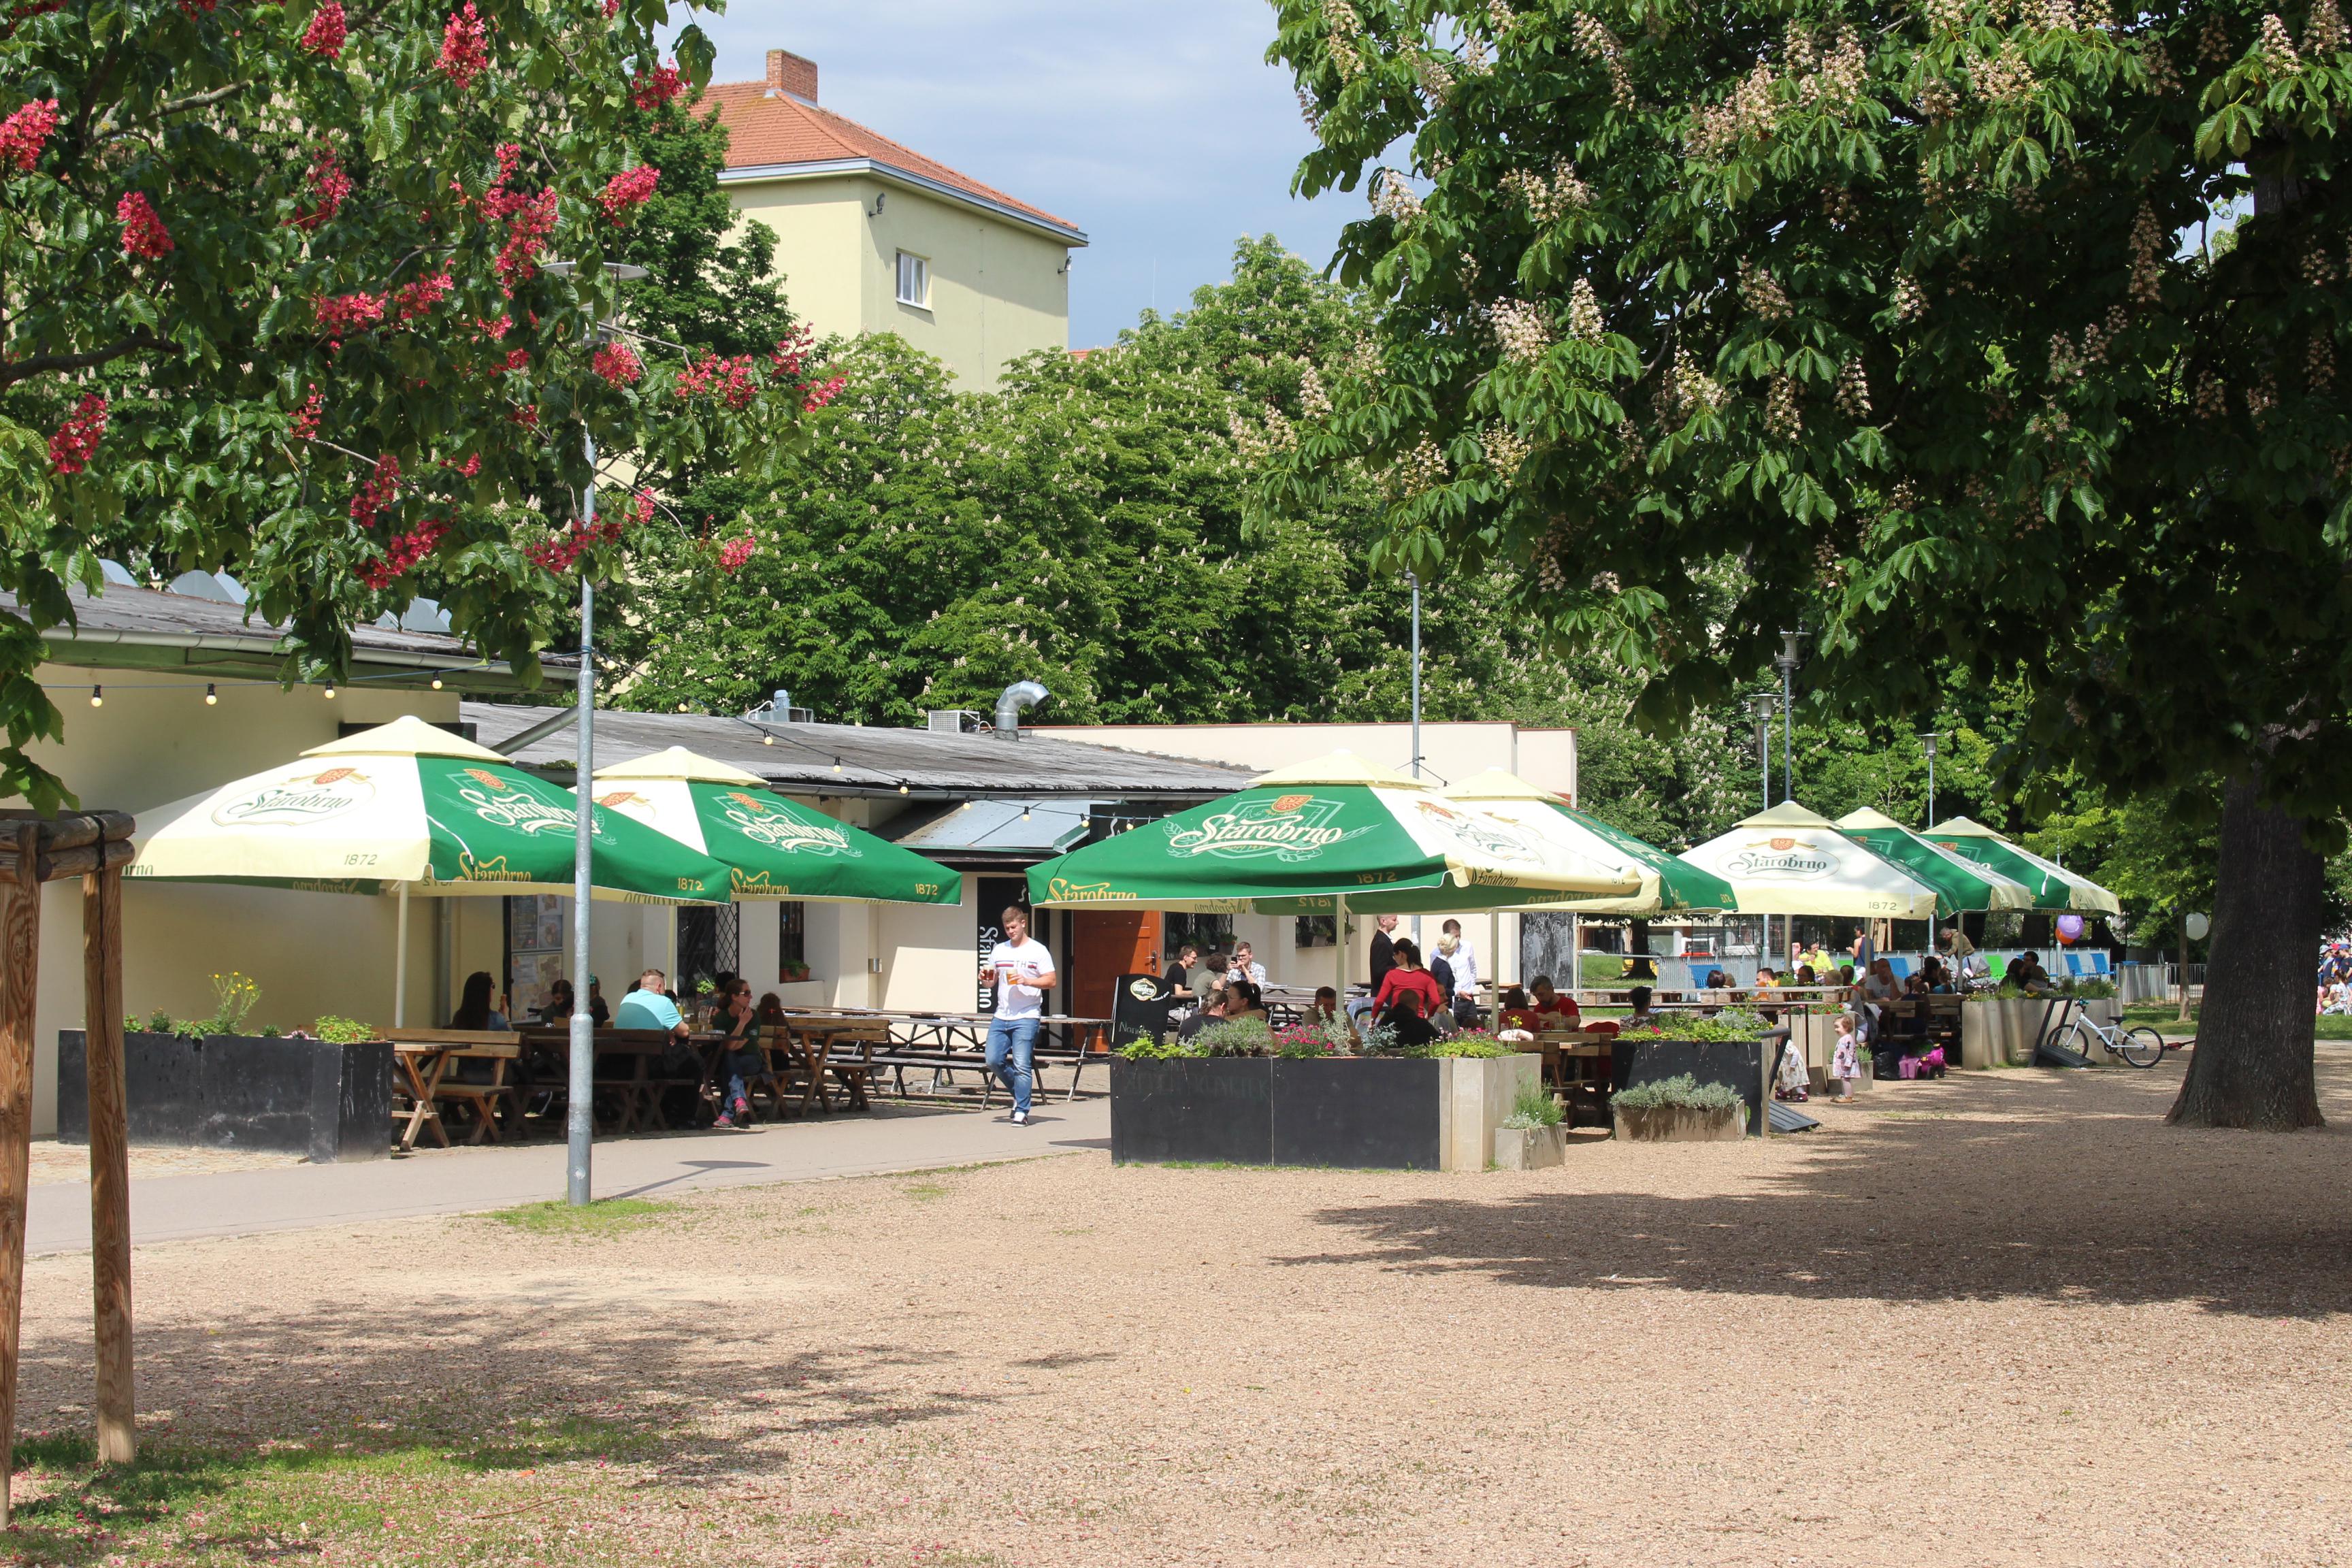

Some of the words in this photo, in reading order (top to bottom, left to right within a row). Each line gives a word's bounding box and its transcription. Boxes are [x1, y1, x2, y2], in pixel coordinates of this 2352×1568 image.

[227, 788, 353, 818] Starobrno
[459, 789, 602, 834] Starobrn
[1170, 814, 1342, 854] Starobrno
[344, 854, 378, 865] 1872
[1728, 853, 1827, 875] Starobrno
[678, 877, 705, 891] 1872
[1356, 872, 1397, 884] 1872
[915, 883, 938, 896] 1872
[1044, 878, 1137, 902] Starobrno
[1868, 902, 1897, 911] 1872
[979, 926, 998, 1009] Starno
